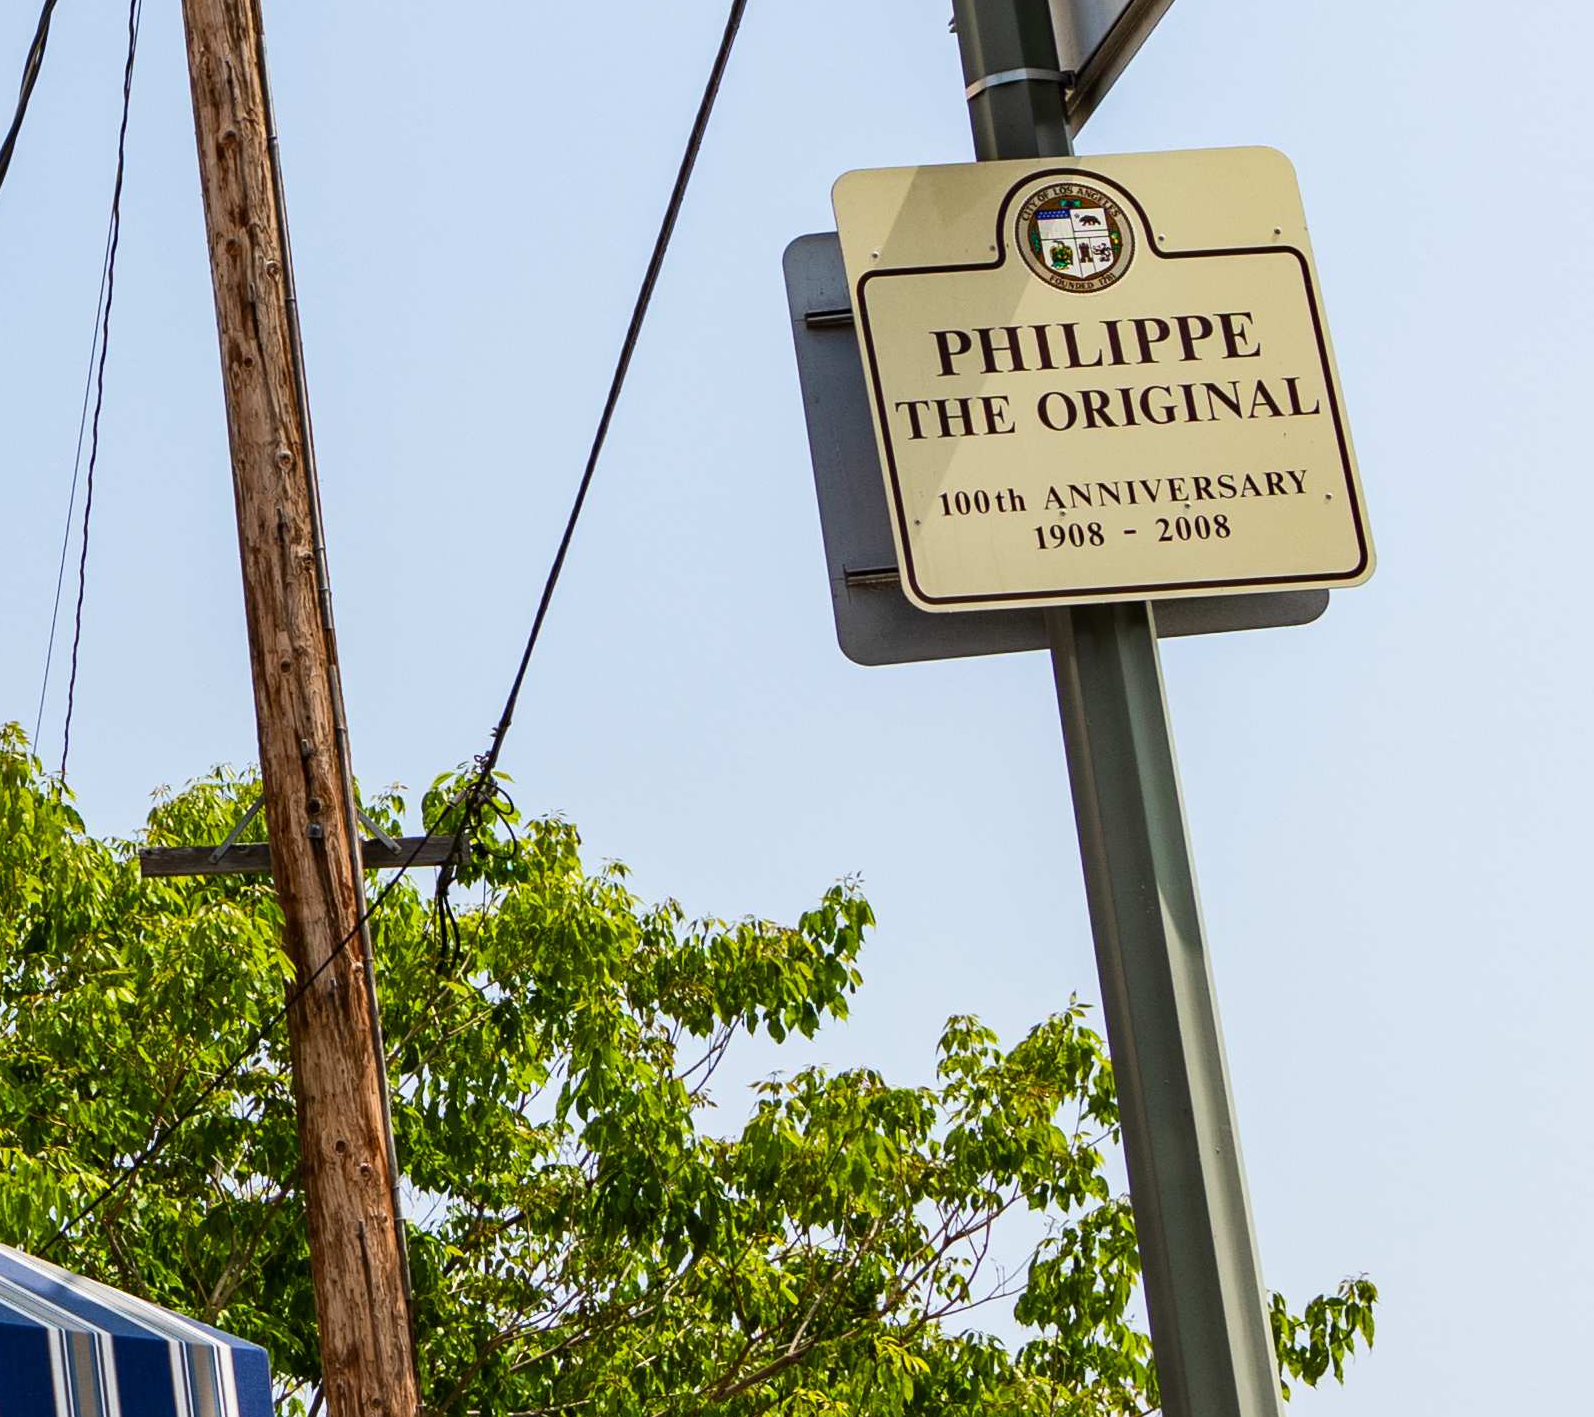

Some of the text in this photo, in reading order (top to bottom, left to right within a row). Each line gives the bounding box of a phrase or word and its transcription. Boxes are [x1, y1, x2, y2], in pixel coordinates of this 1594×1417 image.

[1021, 186, 1120, 222] CITY OF LOS ANGELES
[1049, 273, 1095, 290] FOUNDED
[929, 311, 1262, 377] PHILIPPE
[894, 376, 1321, 441] THE ORIGINAL
[938, 469, 1310, 518] 100th ANNIVERSARY
[1033, 521, 1107, 551] 1908
[1156, 512, 1233, 544] 2008
